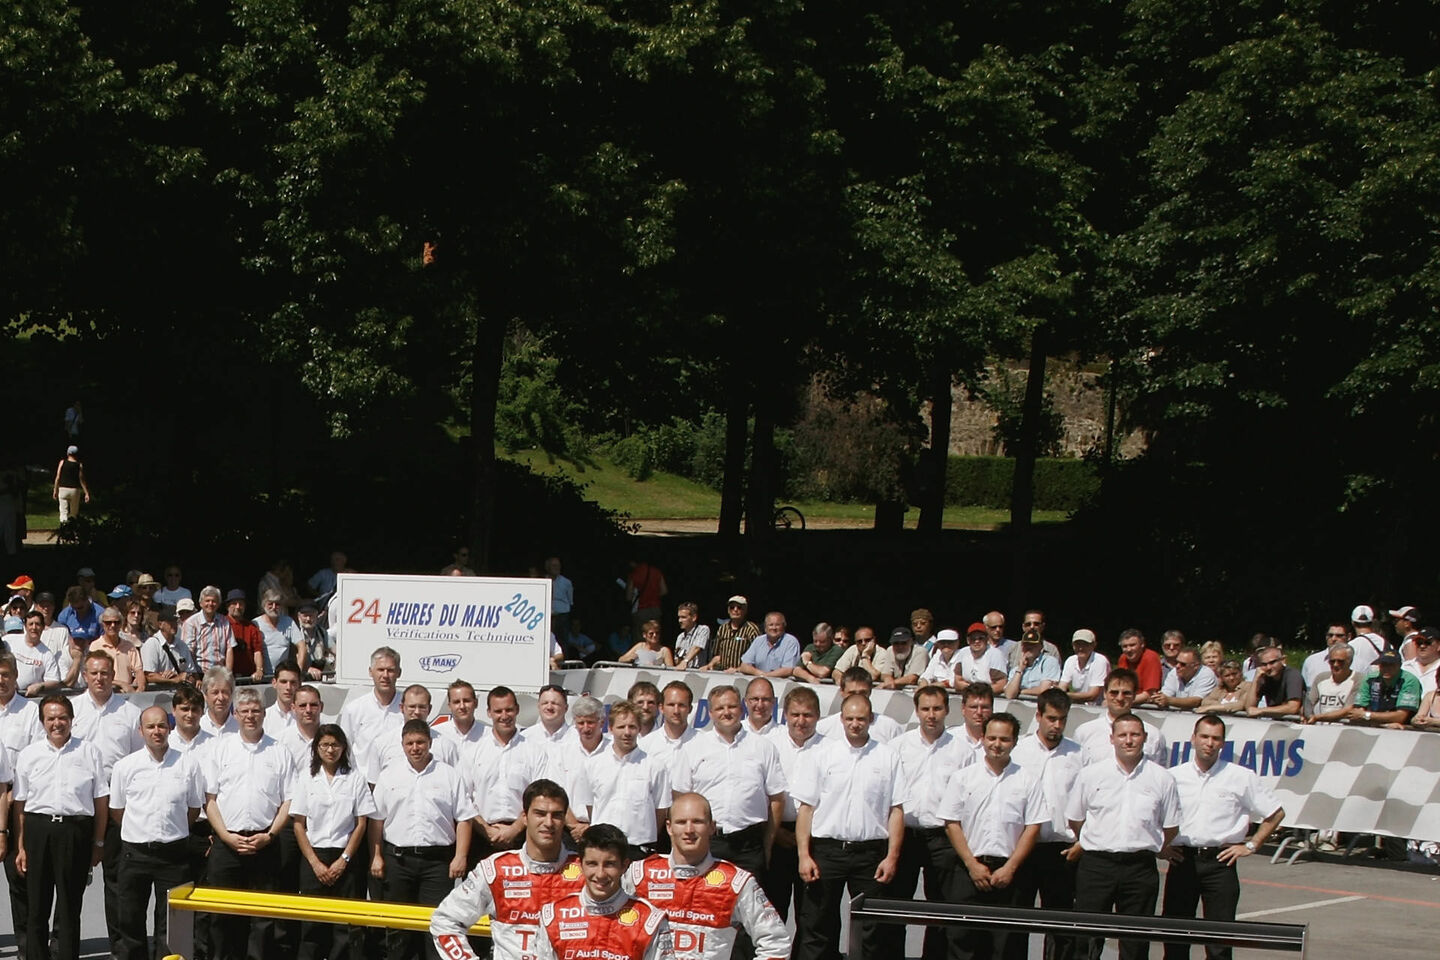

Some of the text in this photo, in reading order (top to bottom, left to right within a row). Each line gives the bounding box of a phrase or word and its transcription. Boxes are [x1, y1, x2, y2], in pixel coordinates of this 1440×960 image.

[347, 598, 504, 628] 24 HEURES DU MANS
[504, 593, 544, 630] 2008
[386, 627, 535, 644] Vérifications Techniques
[433, 658, 457, 667] MANS
[502, 865, 528, 876] TDI
[648, 869, 672, 879] TDI
[521, 911, 541, 919] Aud
[560, 907, 584, 918] TDI
[686, 911, 714, 921] Sport
[669, 929, 705, 953] DI
[576, 950, 600, 958] Audi
